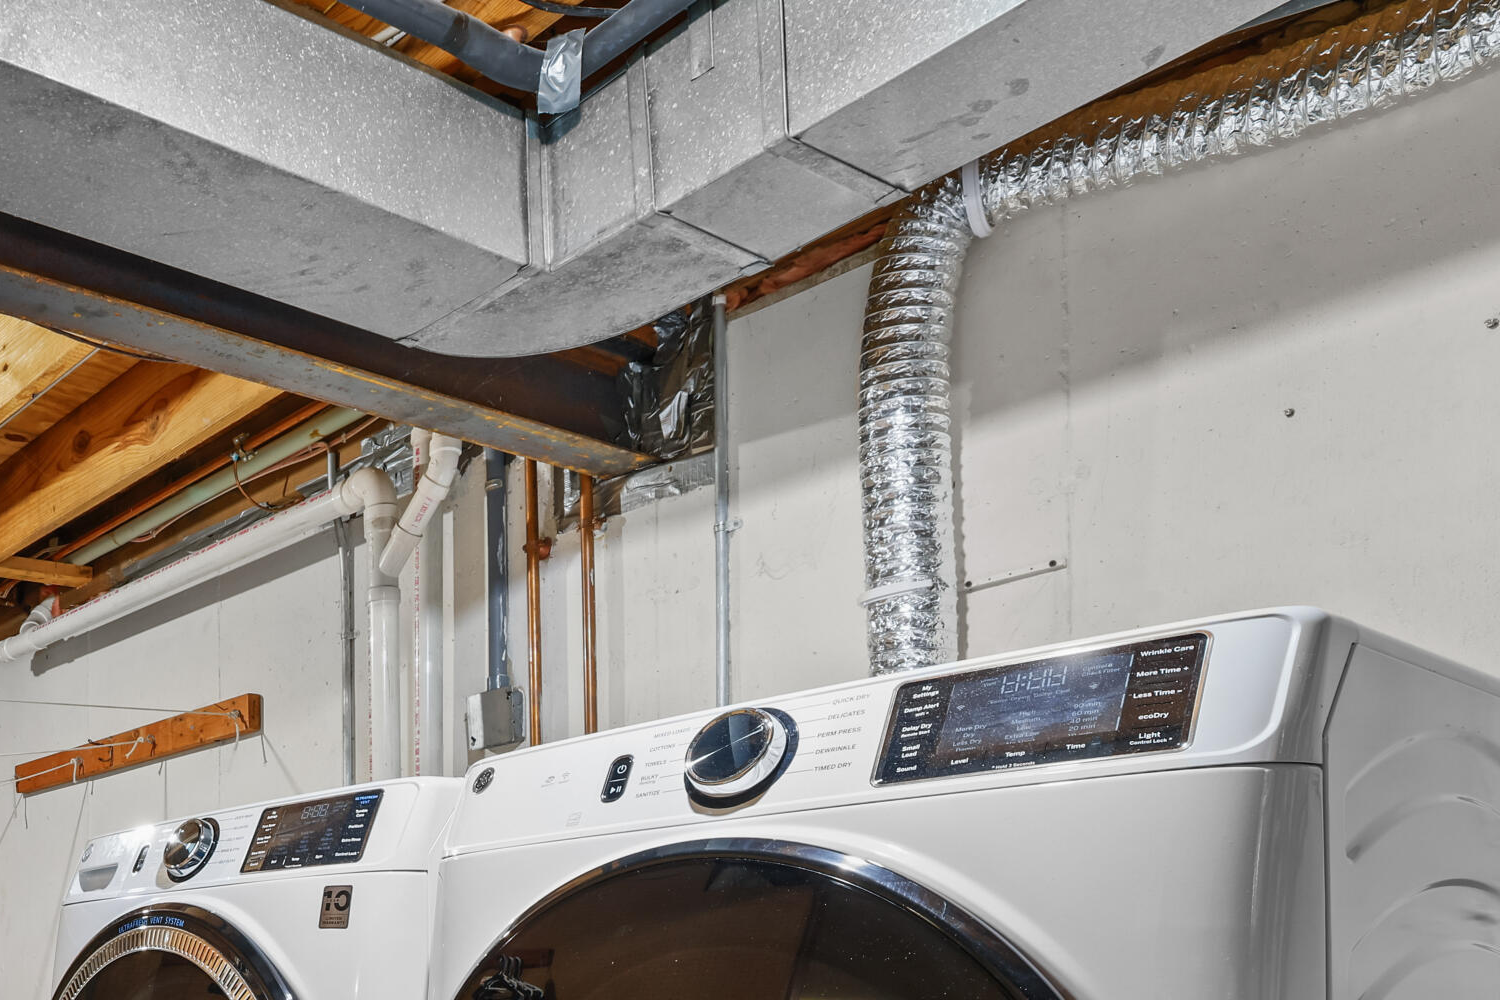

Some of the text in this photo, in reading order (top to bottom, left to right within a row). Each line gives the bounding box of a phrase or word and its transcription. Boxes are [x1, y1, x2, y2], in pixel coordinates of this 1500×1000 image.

[1140, 647, 1172, 657] Wrinkle
[1160, 667, 1181, 675] Time
[1133, 691, 1152, 699] Less
[832, 697, 853, 705] QUICK
[904, 706, 922, 714] Damp
[828, 709, 865, 720] DELICATES
[1138, 711, 1169, 720] ecoDry
[902, 725, 919, 733] Delay
[1138, 731, 1161, 740] Light
[896, 765, 917, 773] Sound
[323, 890, 351, 911] 10
[165, 916, 184, 927] SYSTEM
